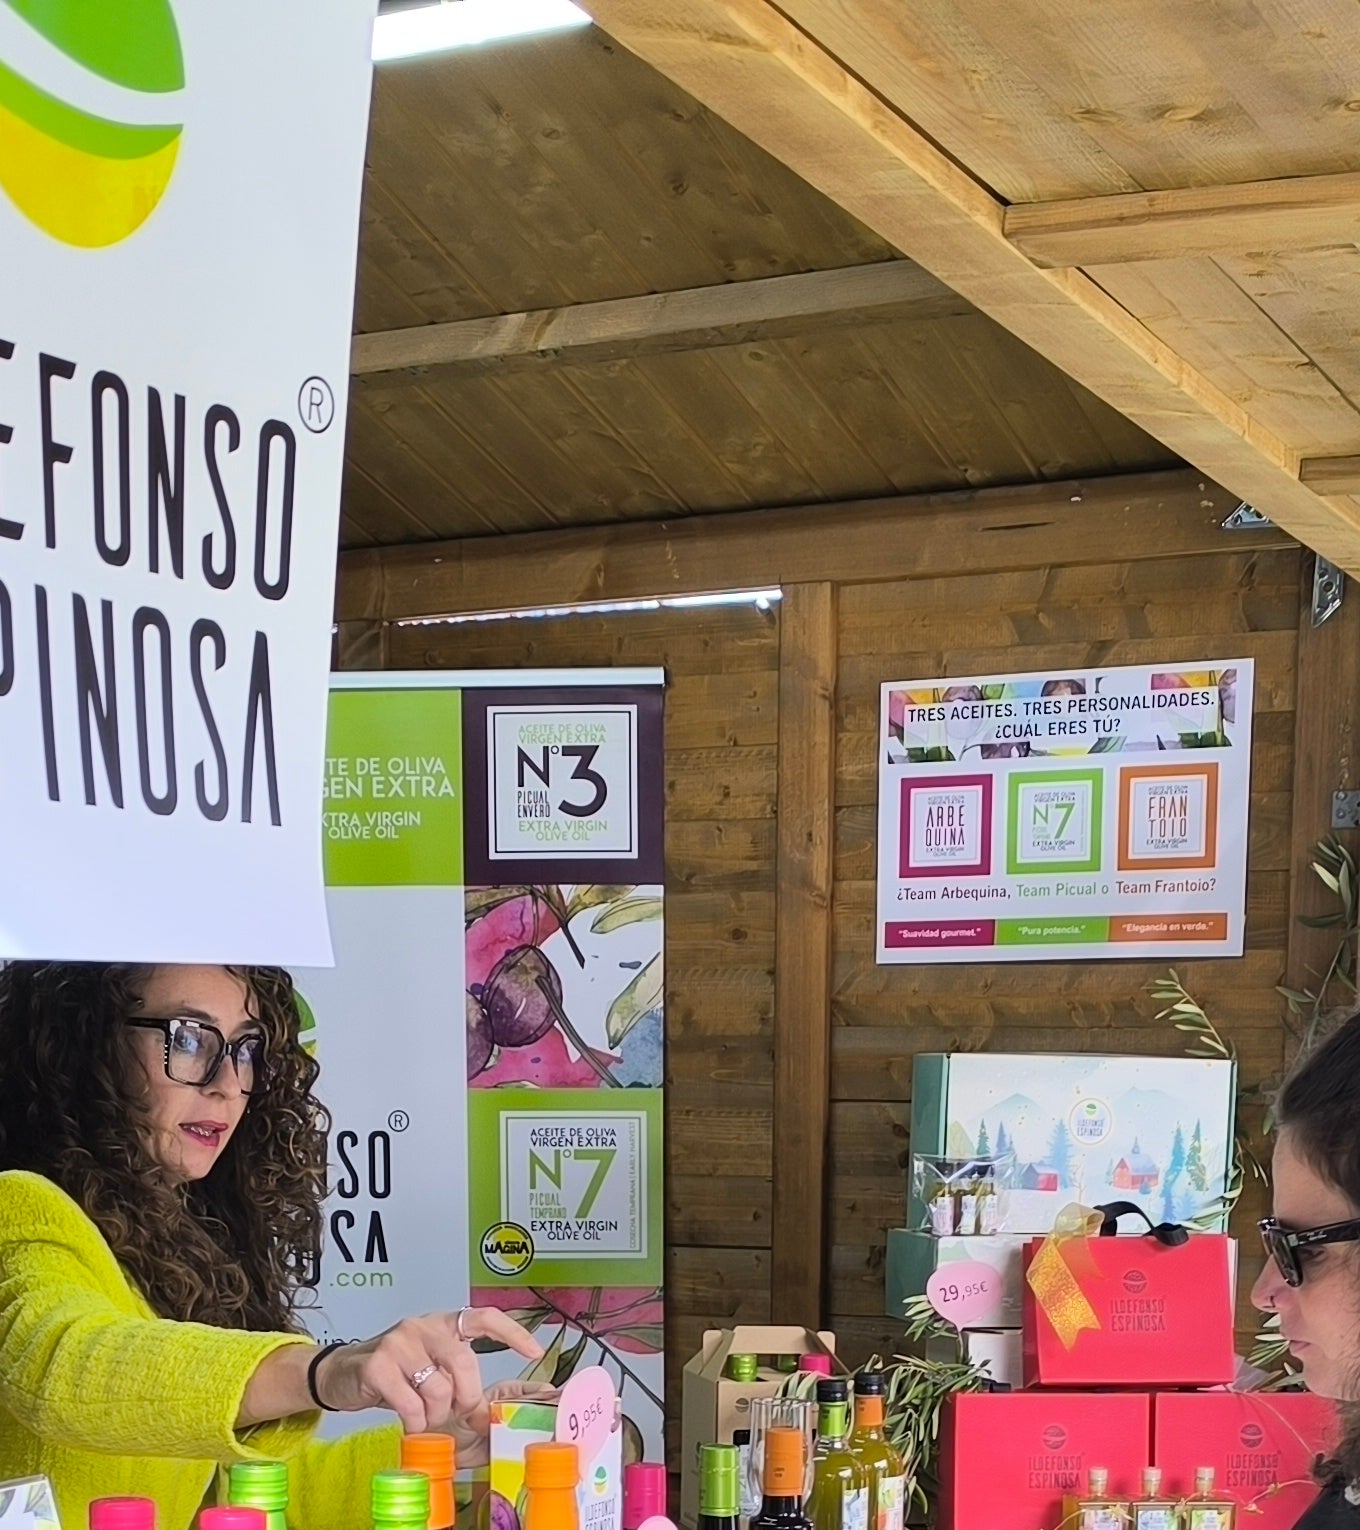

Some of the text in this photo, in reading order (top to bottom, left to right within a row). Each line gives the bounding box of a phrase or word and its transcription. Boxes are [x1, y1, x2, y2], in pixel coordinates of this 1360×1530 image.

[908, 691, 1215, 722] TRES ACEITES. TRES PERSONALIDADES.
[519, 723, 607, 734] ACEITE DE OLIVA
[995, 714, 1121, 738] ¿CUÁL ERES TÚ?
[518, 733, 607, 744] VIRGEN EXTRA
[356, 757, 381, 775] DE
[387, 756, 446, 775] OLIVA
[372, 776, 455, 798] EXTRA
[517, 790, 549, 804] PICUAL
[517, 804, 551, 818] ENVERO
[1148, 796, 1188, 818] FRAN
[322, 811, 421, 827] XTRA VIRGIN
[926, 805, 965, 828] ARBE
[328, 826, 400, 839] OLIVE OIL
[519, 820, 608, 832] EXTRA VIRGIN
[1148, 818, 1188, 838] TOIO
[536, 831, 591, 841] OLIVE OIL
[925, 828, 965, 847] QUINA
[897, 878, 1217, 901] ¿Team Arbequina, Team Picual o Team Frantoio?
[530, 1127, 617, 1137] ACEITE DE OLIVA
[530, 1137, 617, 1147] VIRGEN EXTRA
[529, 1193, 561, 1206] PICUAL
[530, 1220, 618, 1232] EXTRA VIRGIN
[547, 1231, 601, 1241] OLIVE OIL
[940, 1280, 989, 1303] 29,95€
[1110, 1299, 1164, 1314] ILDEFONSO
[1111, 1315, 1166, 1332] ESPINOSA
[569, 1396, 604, 1441] 9,95€
[1029, 1455, 1081, 1470] ILDEFONSO
[1227, 1453, 1279, 1469] ILDEFONSO
[1029, 1472, 1081, 1489] ESPINOSA
[1226, 1470, 1278, 1487] ESPINOSA
